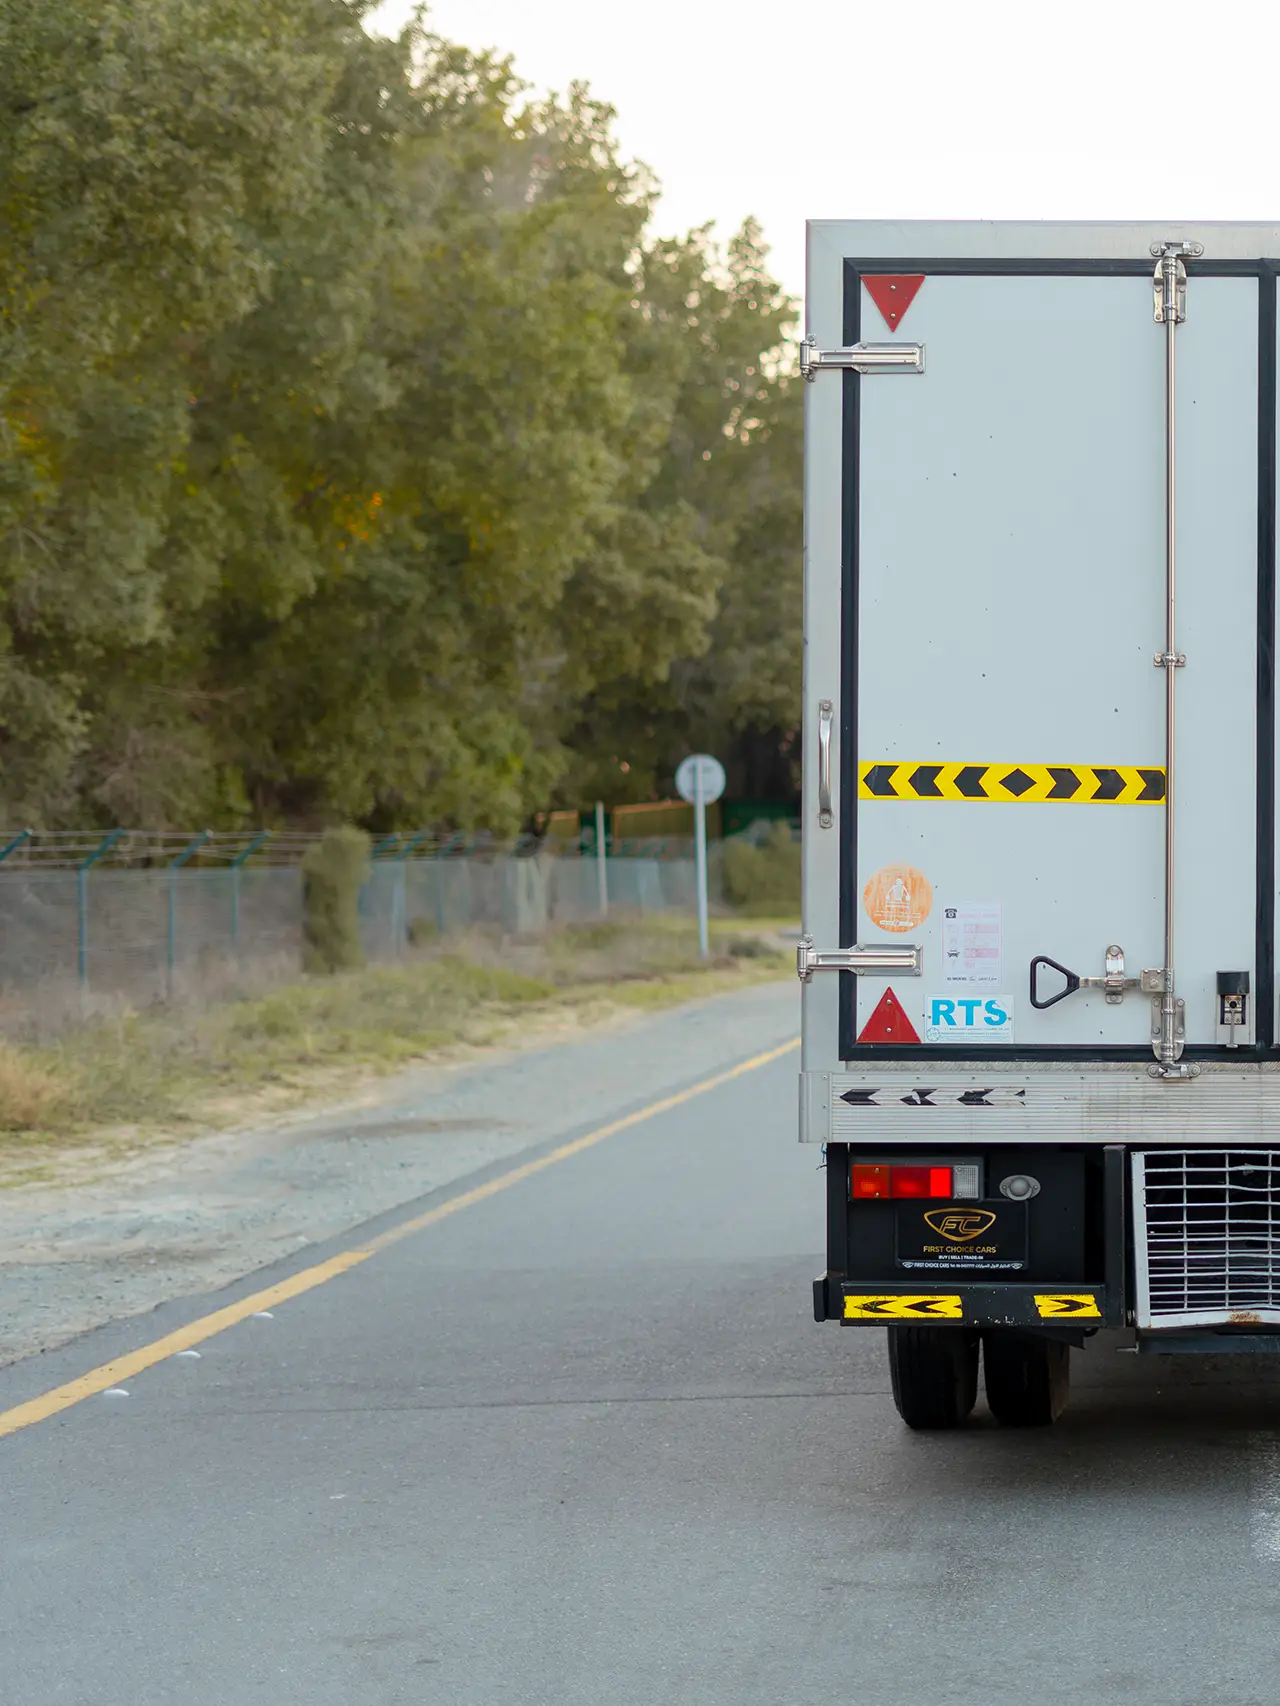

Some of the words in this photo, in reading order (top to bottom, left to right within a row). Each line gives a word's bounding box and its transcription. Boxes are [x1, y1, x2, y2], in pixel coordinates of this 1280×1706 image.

[932, 999, 1007, 1026] RTS
[923, 1245, 944, 1253] FIRST
[945, 1245, 974, 1253] CHOICE
[975, 1246, 997, 1254] CARS
